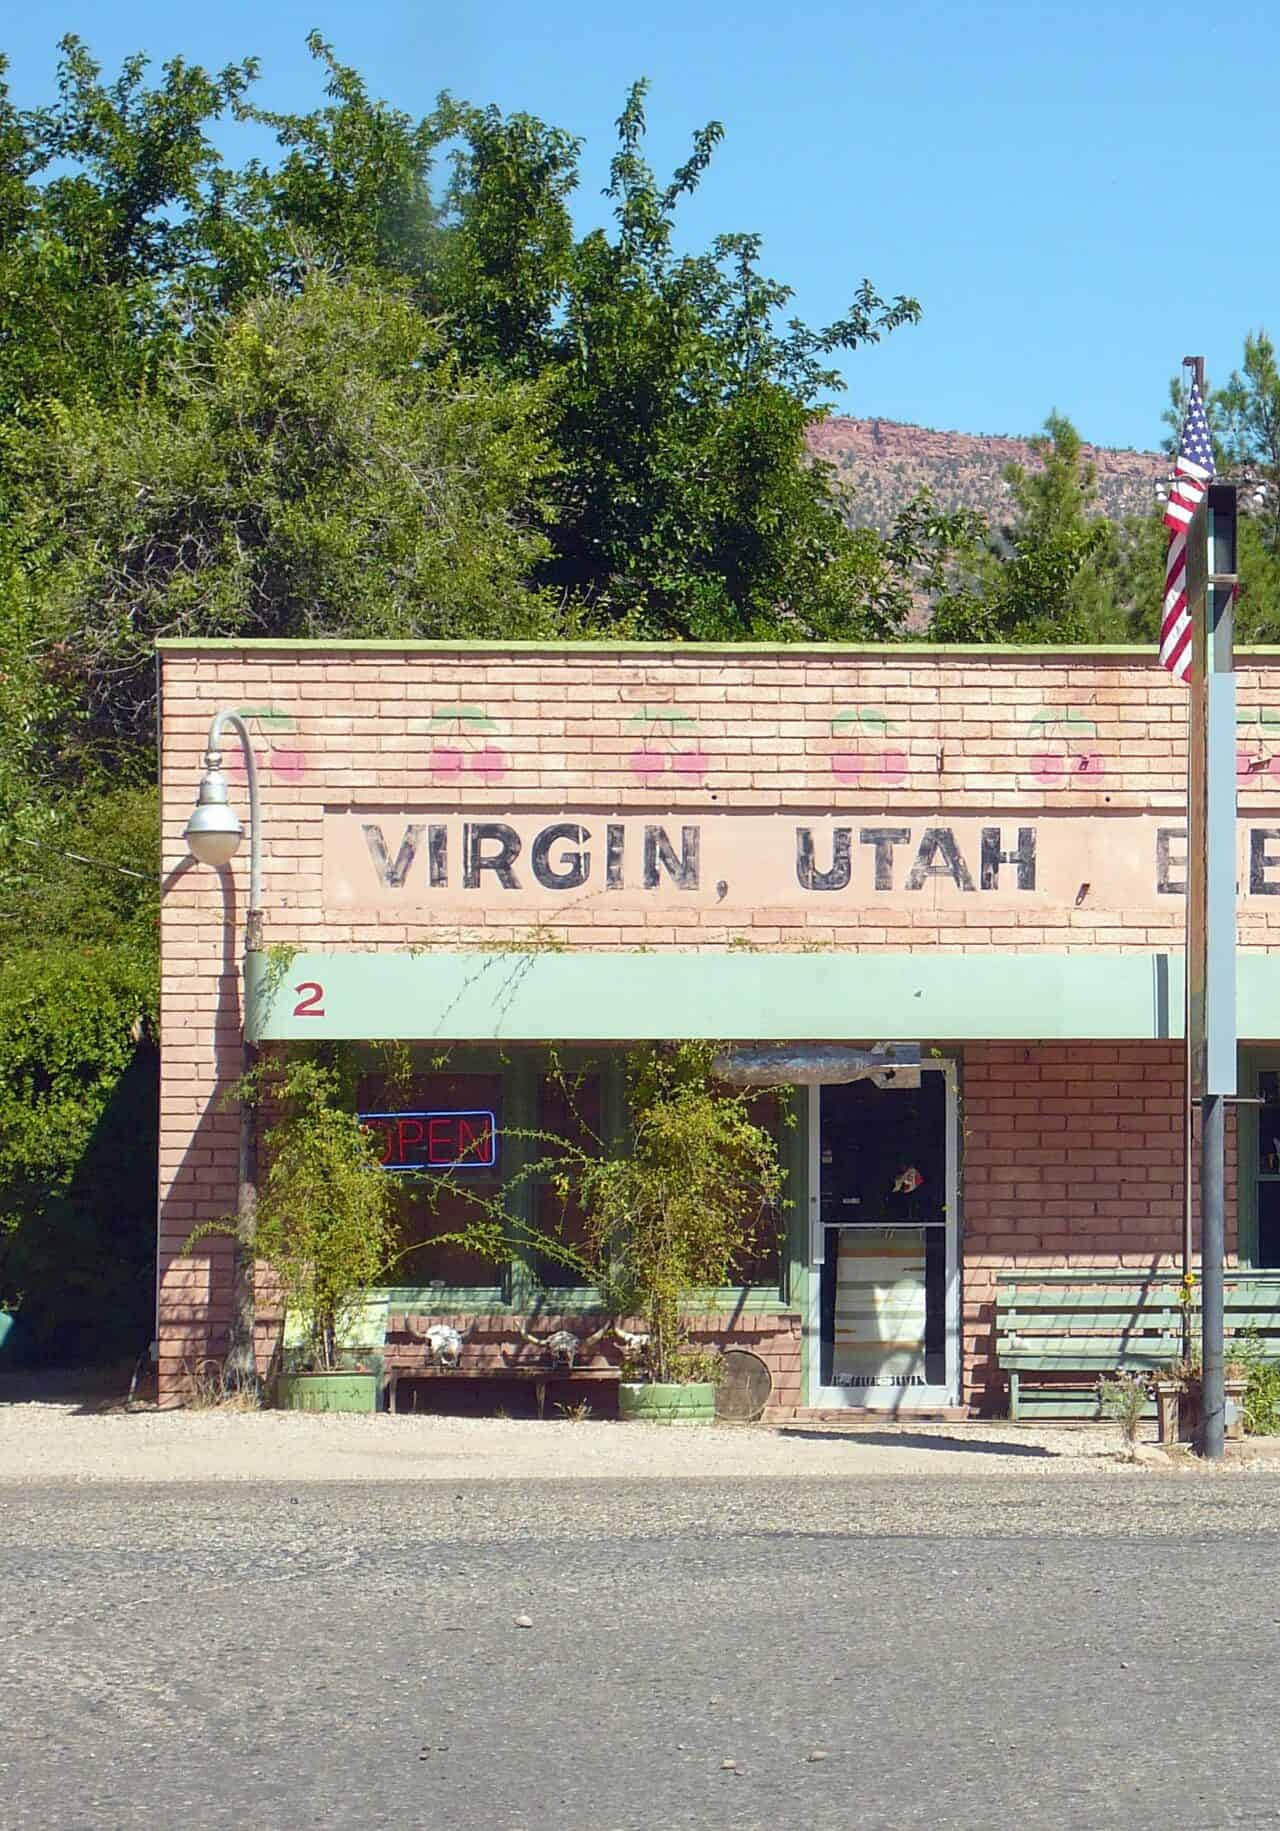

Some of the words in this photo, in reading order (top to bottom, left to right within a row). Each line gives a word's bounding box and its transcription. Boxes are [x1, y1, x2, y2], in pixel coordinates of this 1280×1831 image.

[361, 823, 729, 903] VIRGIN,
[796, 826, 1037, 892] UTAH
[293, 982, 325, 1016] 2
